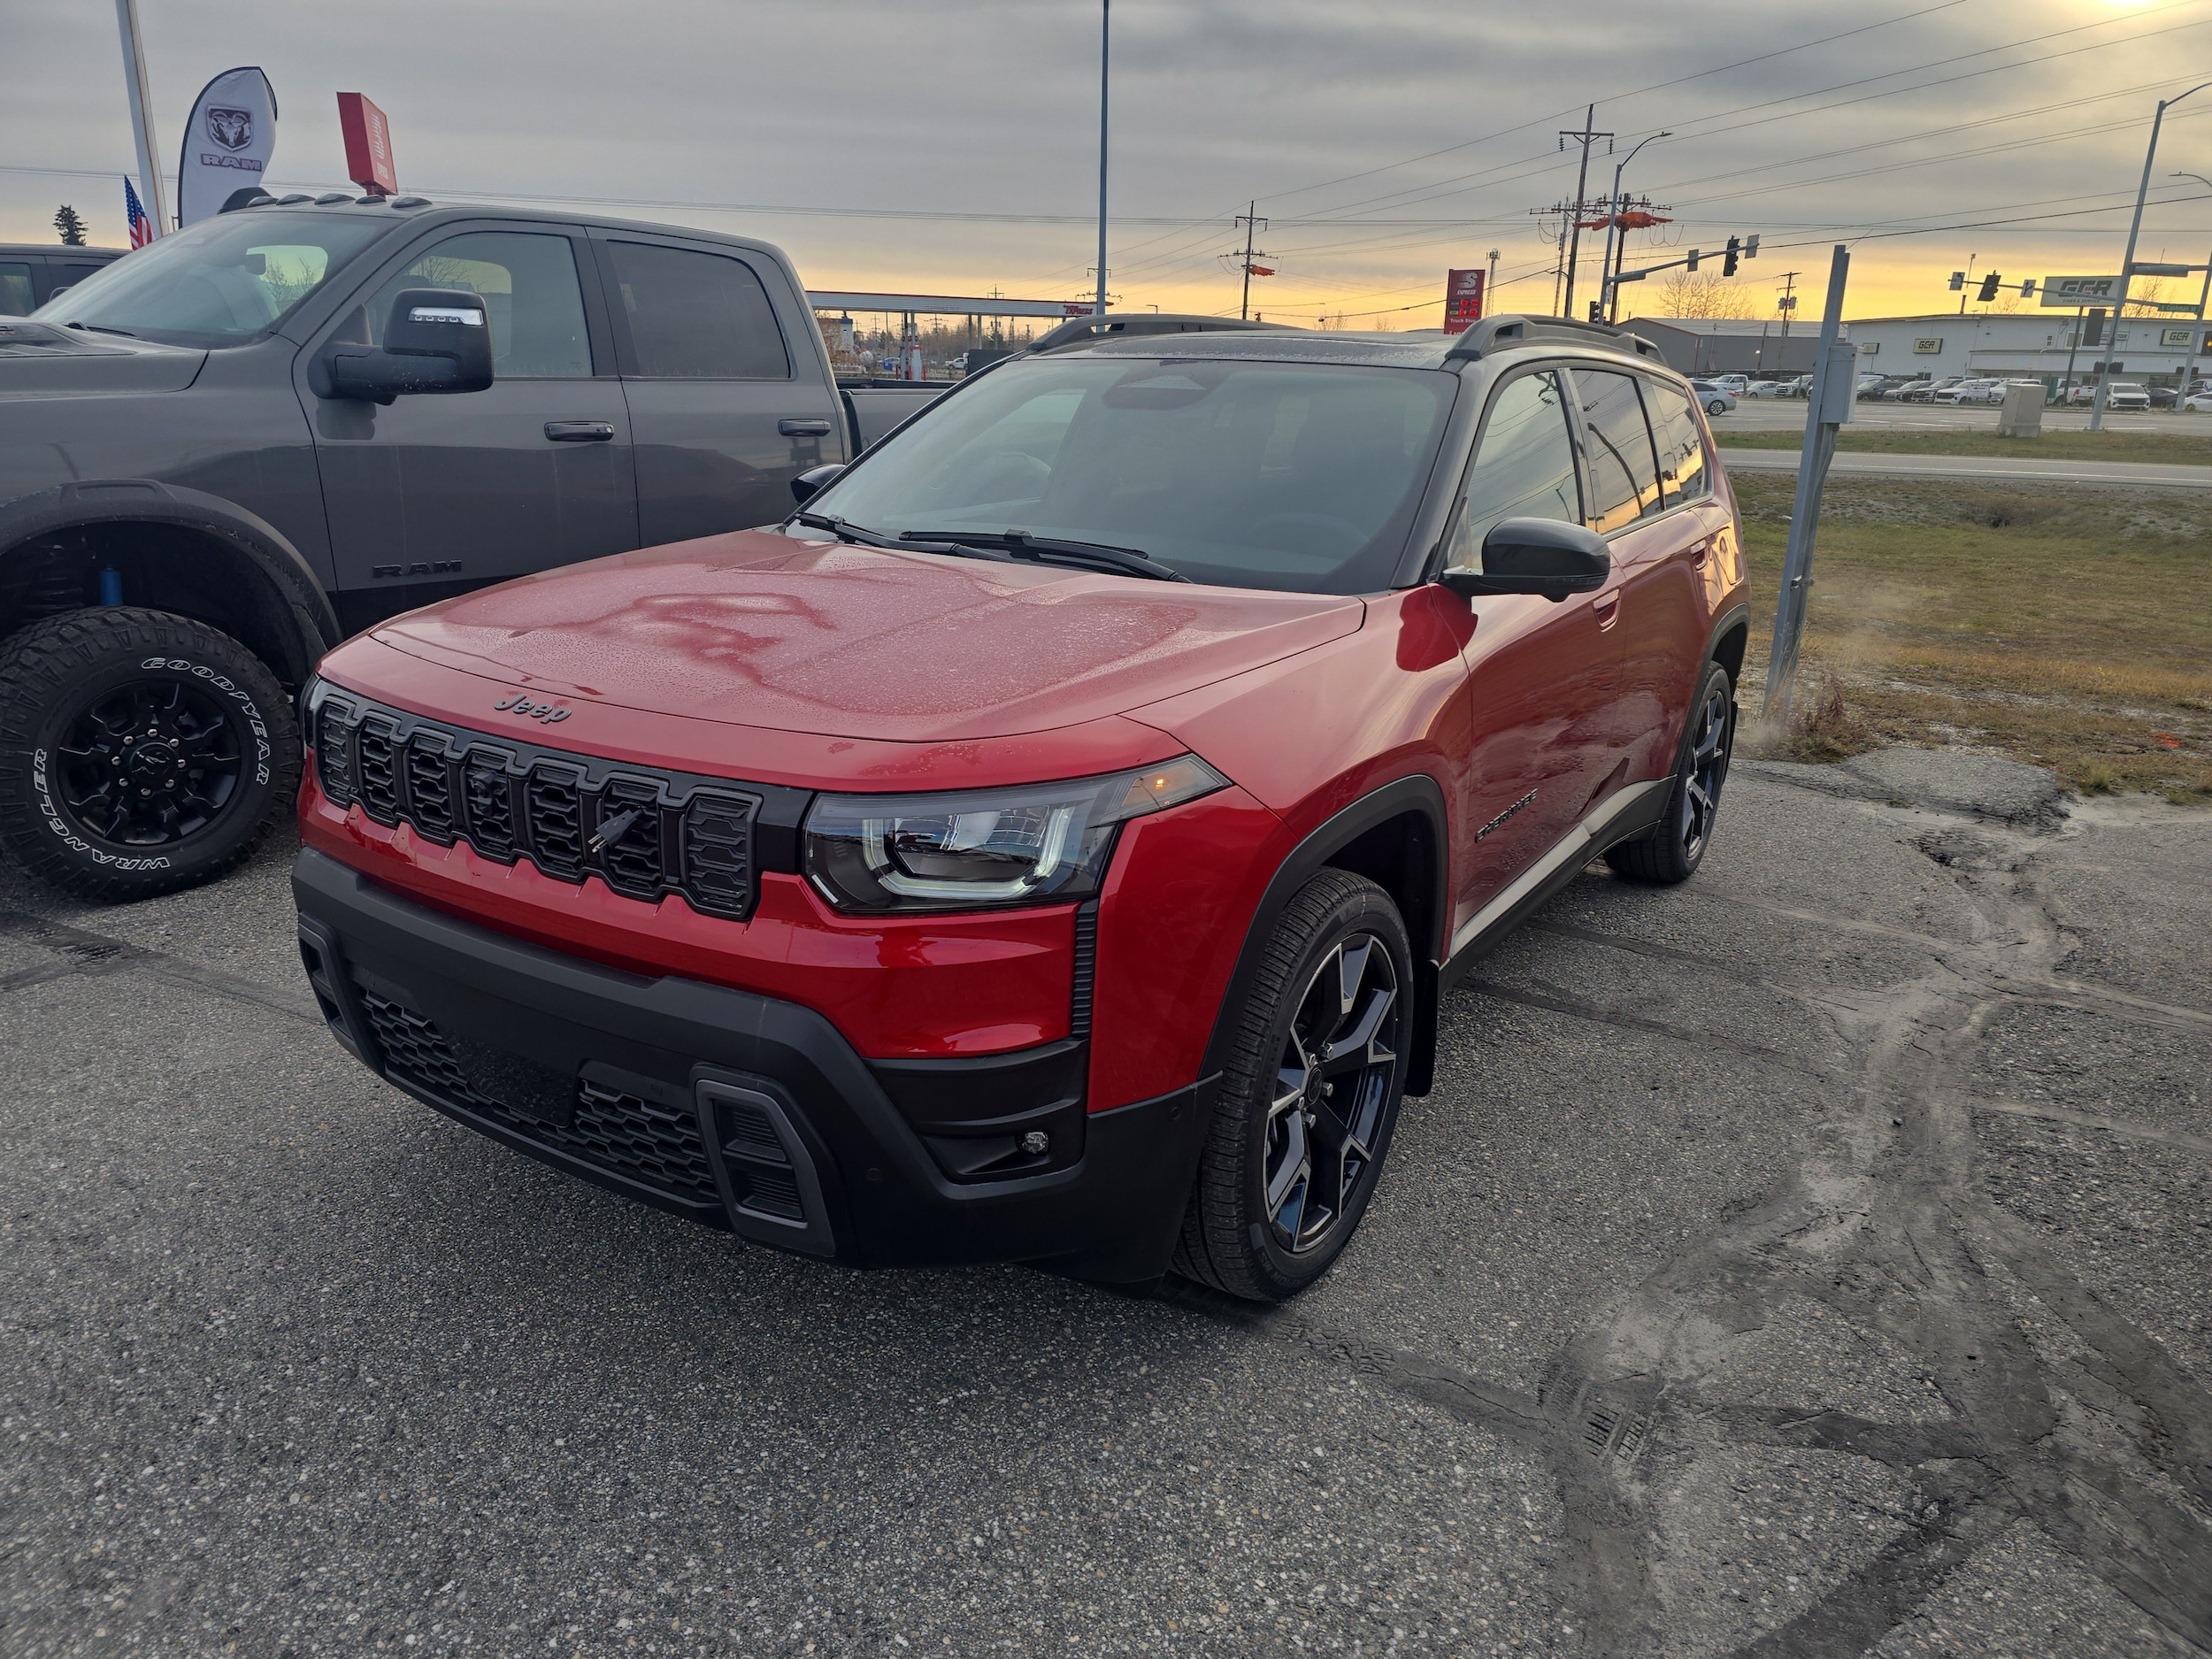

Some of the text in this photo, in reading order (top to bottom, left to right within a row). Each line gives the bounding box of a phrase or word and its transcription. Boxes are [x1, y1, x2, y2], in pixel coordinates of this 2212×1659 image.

[201, 153, 262, 172] RAM
[2058, 280, 2113, 297] GCR
[1918, 341, 1935, 349] GCR
[2169, 332, 2190, 342] GCR
[373, 559, 462, 579] RAM
[494, 694, 572, 725] Jeep
[142, 657, 270, 786] GOODYEAR
[34, 749, 171, 871] WRANGLER
[1475, 787, 1539, 843] CHEROKEE
